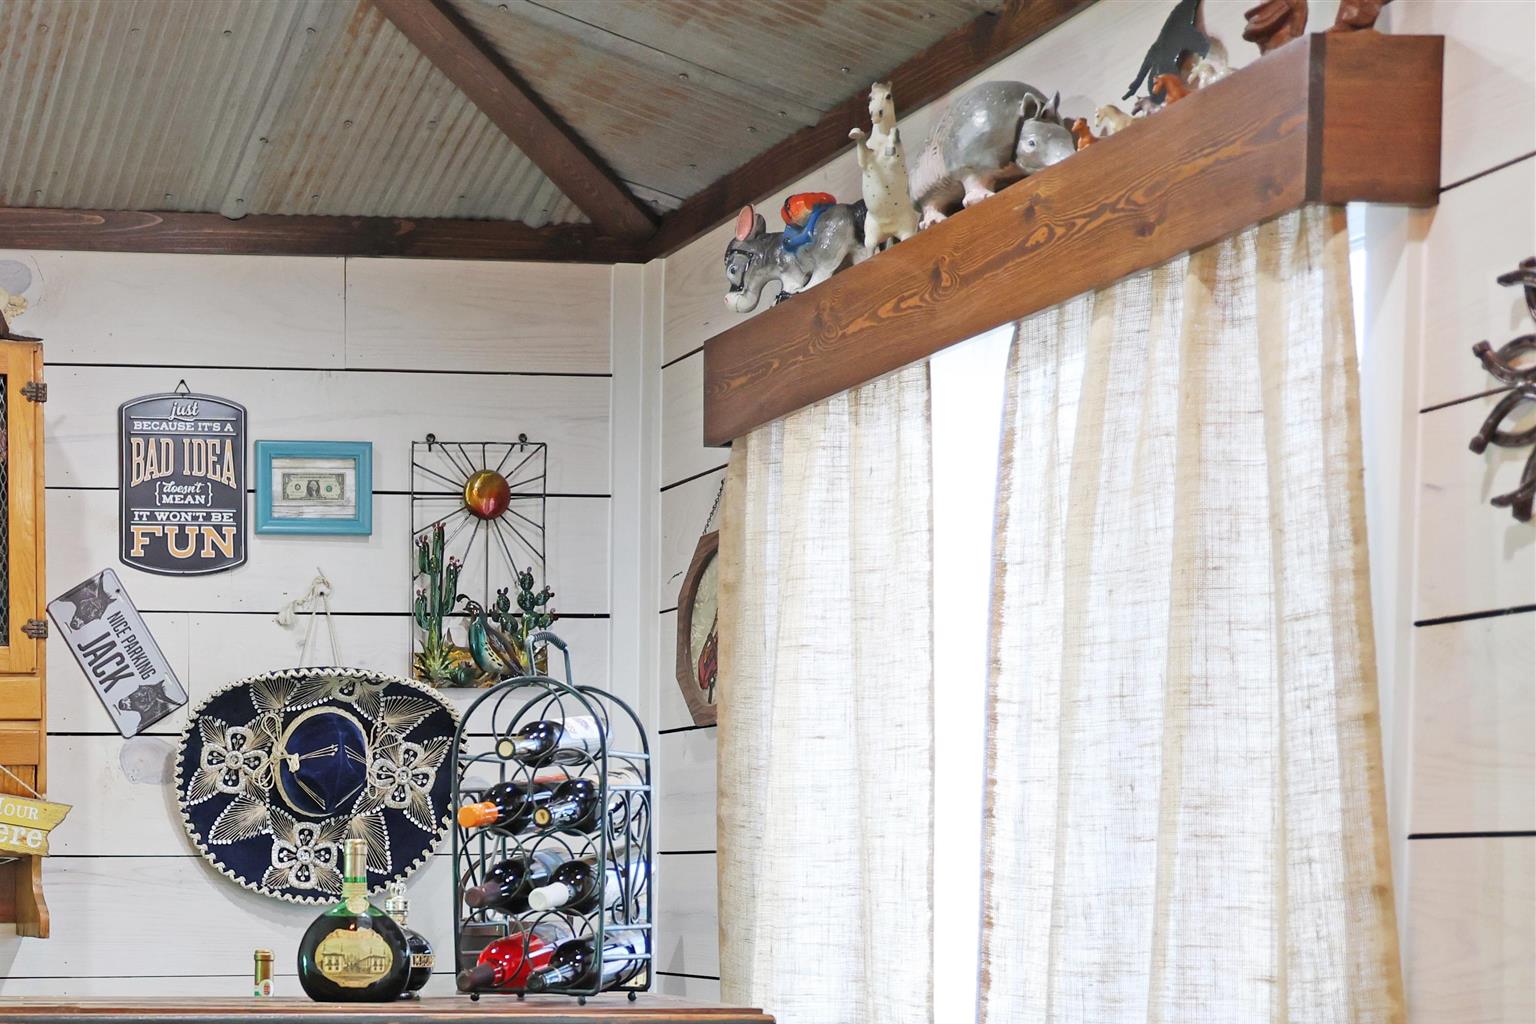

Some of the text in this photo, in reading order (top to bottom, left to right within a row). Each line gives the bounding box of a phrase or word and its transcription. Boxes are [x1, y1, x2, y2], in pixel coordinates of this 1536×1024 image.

[168, 402, 199, 421] just
[133, 421, 234, 432] BECAUSE IT'S A
[130, 437, 237, 489] BAD IDEA
[161, 494, 206, 505] MEAN
[133, 511, 234, 522] IT WON'T BE
[130, 525, 237, 559] FUN
[106, 610, 157, 681] NICE PARKING
[76, 630, 135, 694] JACK
